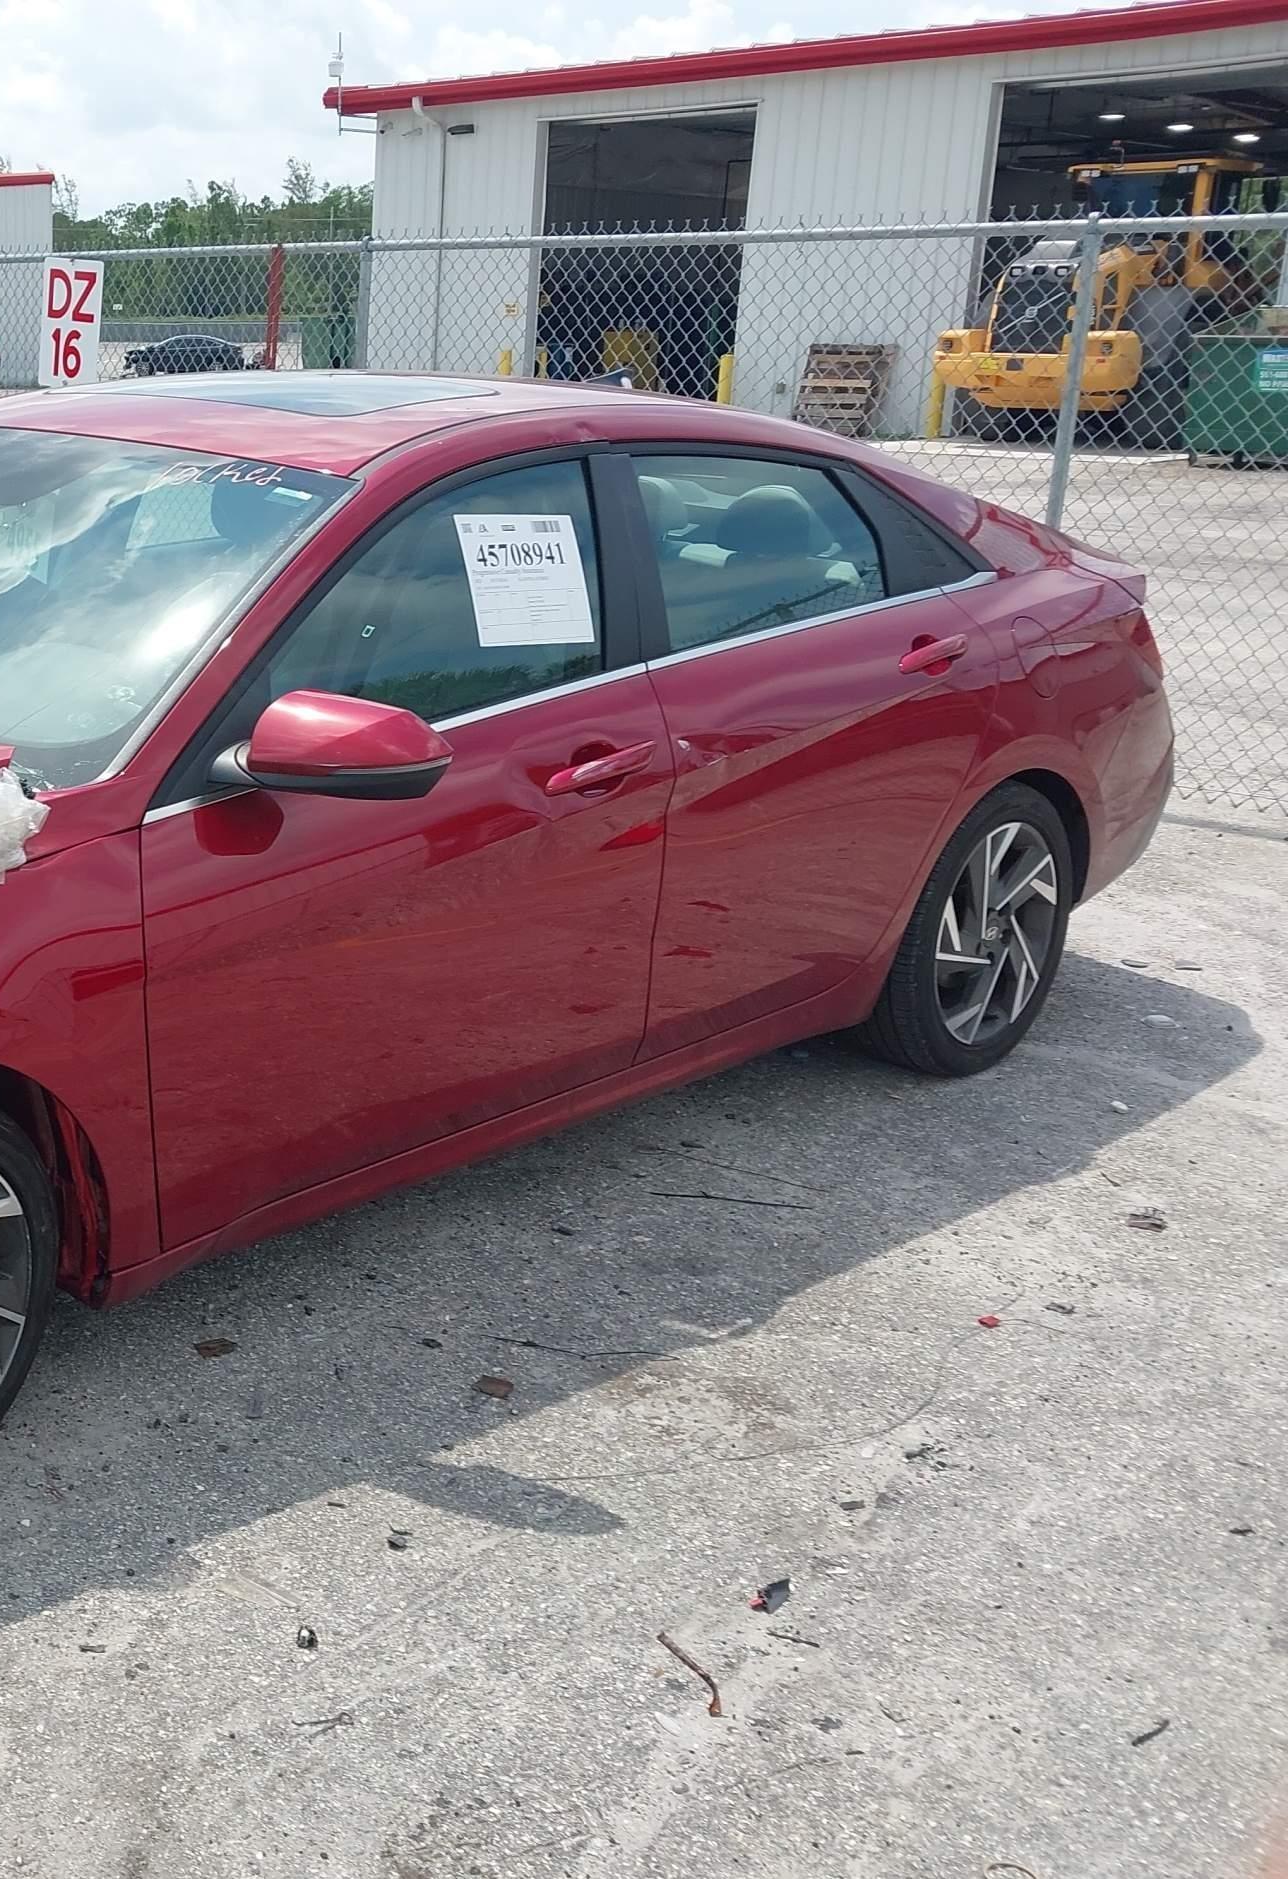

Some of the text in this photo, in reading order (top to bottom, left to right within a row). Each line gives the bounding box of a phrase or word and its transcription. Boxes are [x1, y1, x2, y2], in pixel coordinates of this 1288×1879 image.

[47, 268, 97, 323] DZ
[52, 327, 82, 379] 16
[476, 542, 567, 567] 45708941
